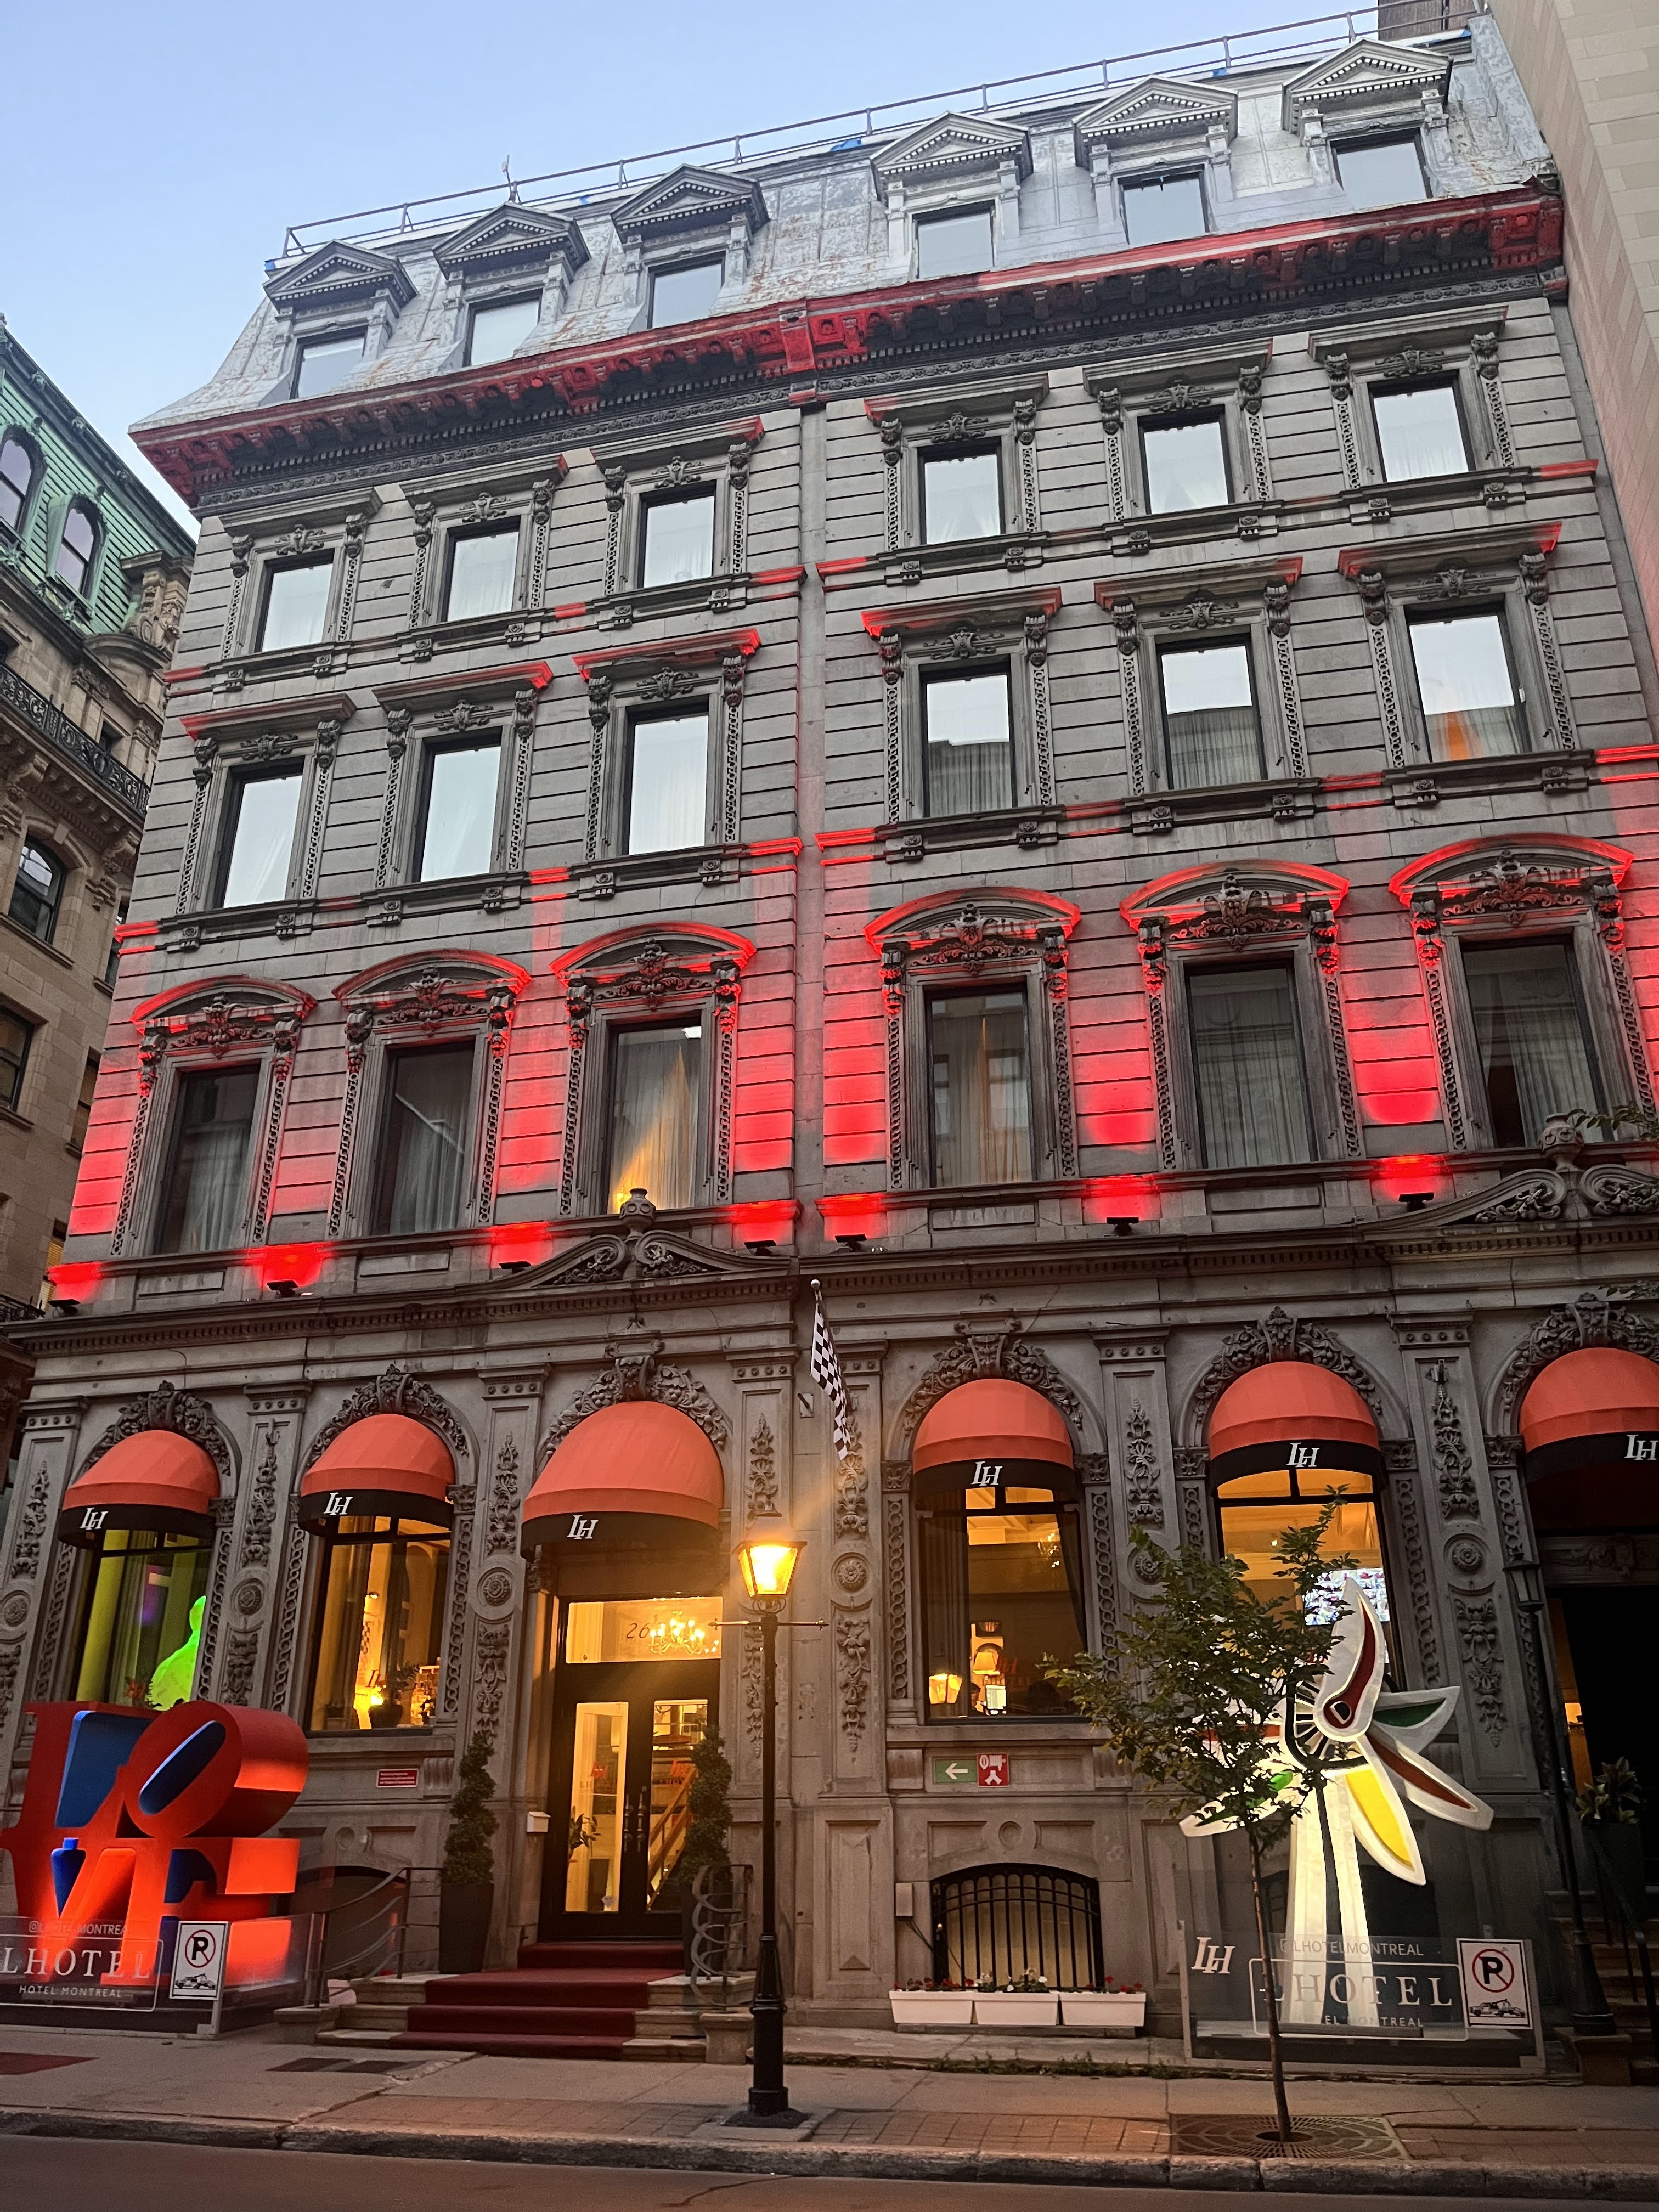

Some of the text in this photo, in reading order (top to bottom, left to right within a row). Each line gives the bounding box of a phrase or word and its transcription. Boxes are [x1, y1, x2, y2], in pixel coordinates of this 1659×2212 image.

[1286, 1442, 1320, 1468] LH
[1624, 1434, 1659, 1460] LH
[970, 1461, 1003, 1486] LH
[323, 1492, 353, 1515] LH
[80, 1507, 108, 1530] LH
[567, 1515, 599, 1539] LH
[39, 1921, 132, 1936] LOTEMONTREAL
[1190, 1937, 1235, 1974] LH
[19, 1984, 122, 1998] HOTEL MONTREAL
